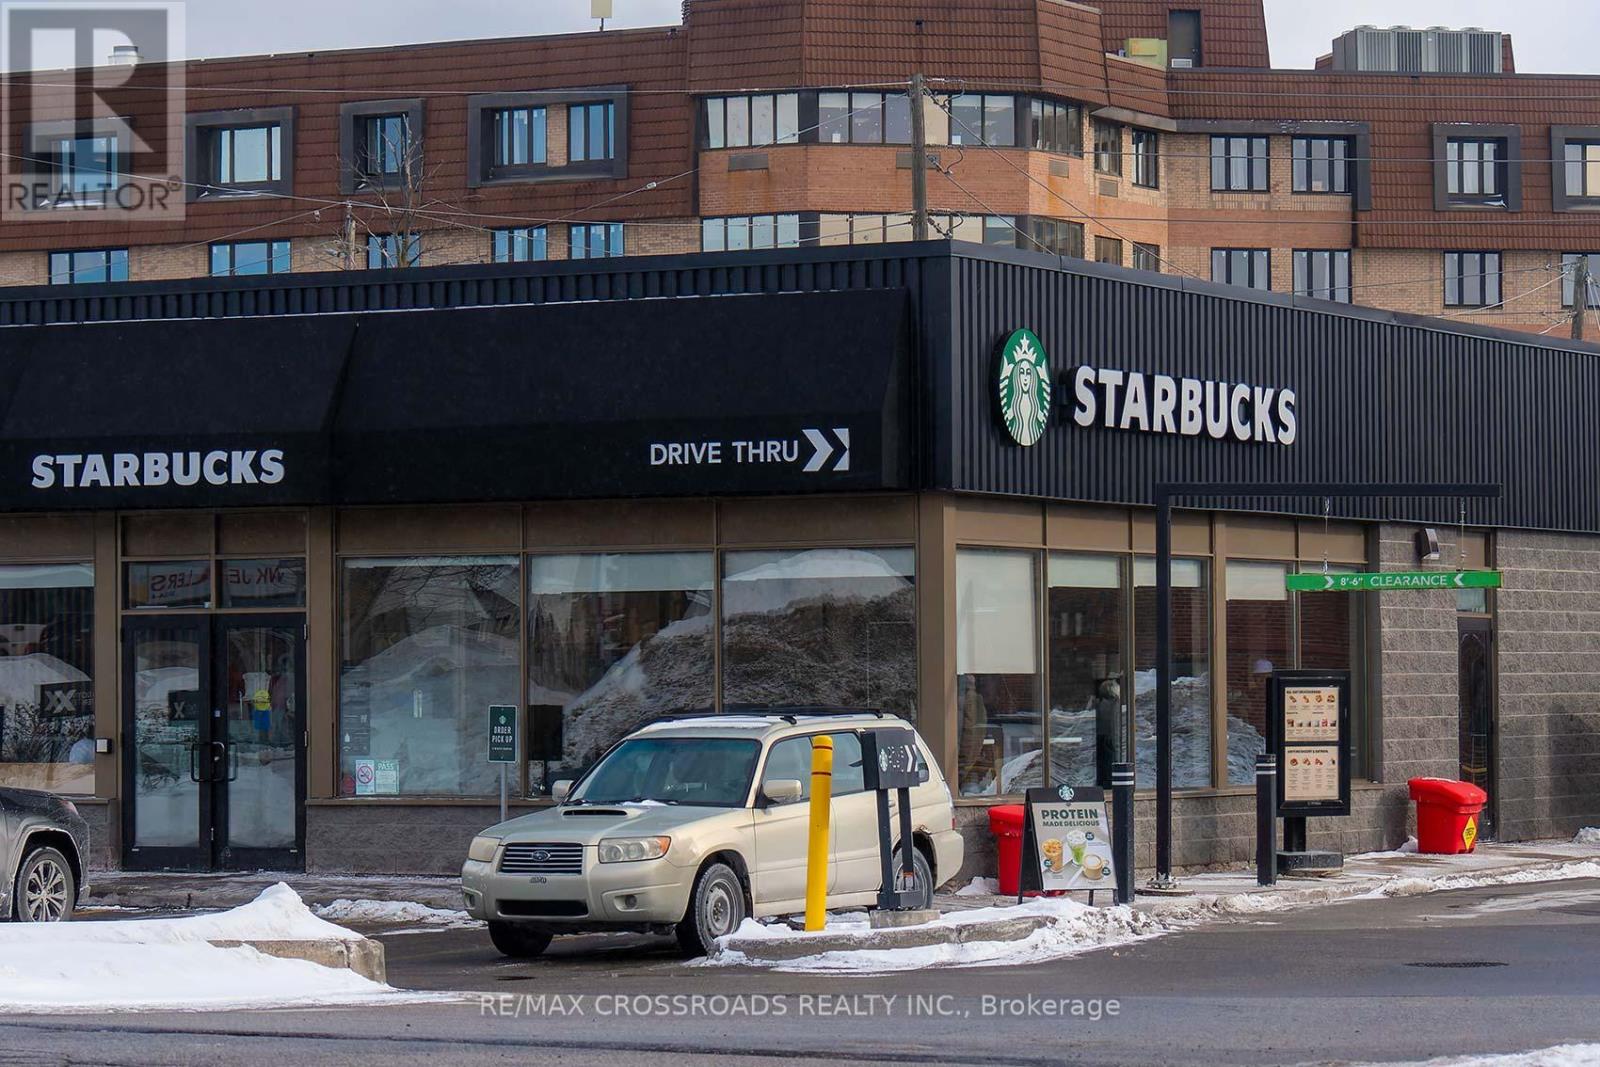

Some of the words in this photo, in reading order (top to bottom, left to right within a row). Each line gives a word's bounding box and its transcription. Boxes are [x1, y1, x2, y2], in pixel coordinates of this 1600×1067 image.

[1073, 365, 1297, 446] STARBUCKS
[650, 442, 722, 465] DRIVE
[731, 440, 799, 463] THRU
[31, 449, 285, 489] STARBUCKS
[1369, 575, 1448, 587] CLEARANCE
[493, 726, 512, 734] ORDER
[491, 735, 504, 743] PICK
[1041, 808, 1099, 820] PROTEIN
